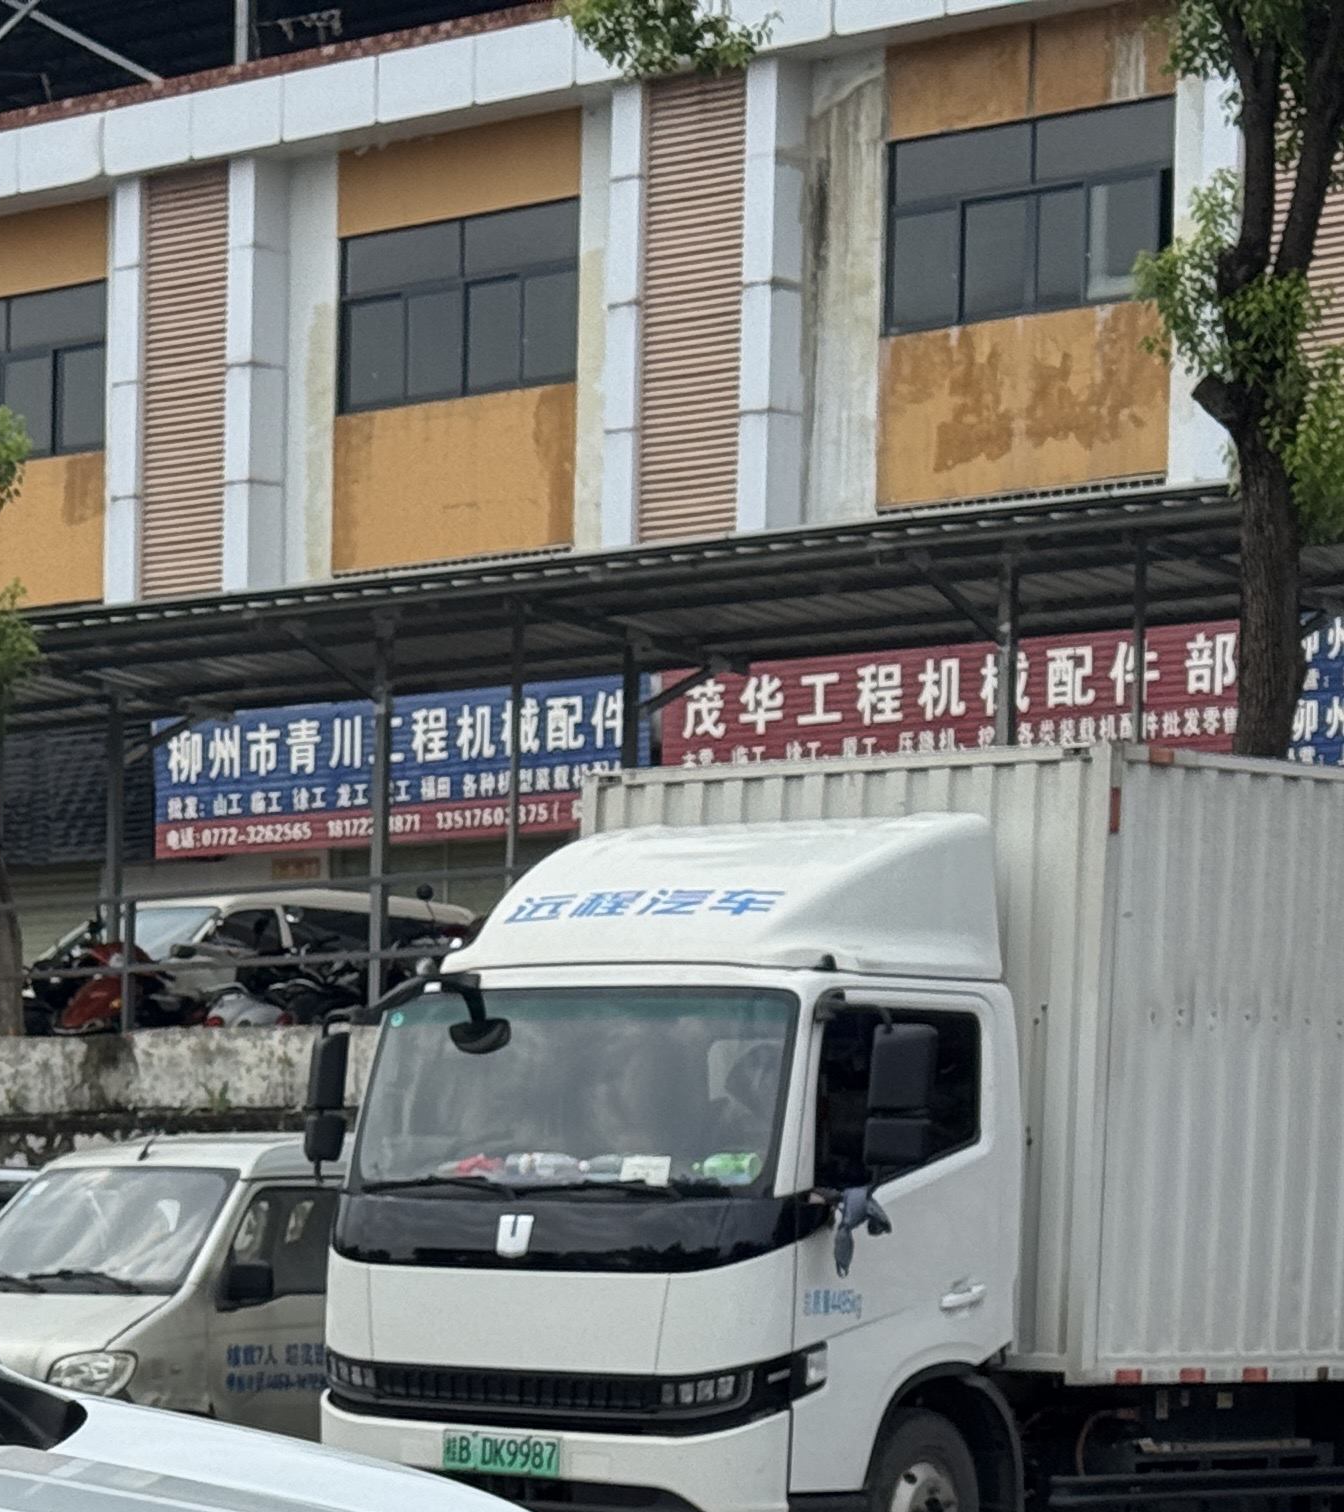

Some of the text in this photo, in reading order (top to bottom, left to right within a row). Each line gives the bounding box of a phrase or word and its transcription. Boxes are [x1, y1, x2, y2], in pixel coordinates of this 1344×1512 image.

[682, 632, 1237, 740] 茂华工程机械配件部
[504, 889, 787, 924] 远程汽车
[480, 1437, 558, 1470] DK9987
